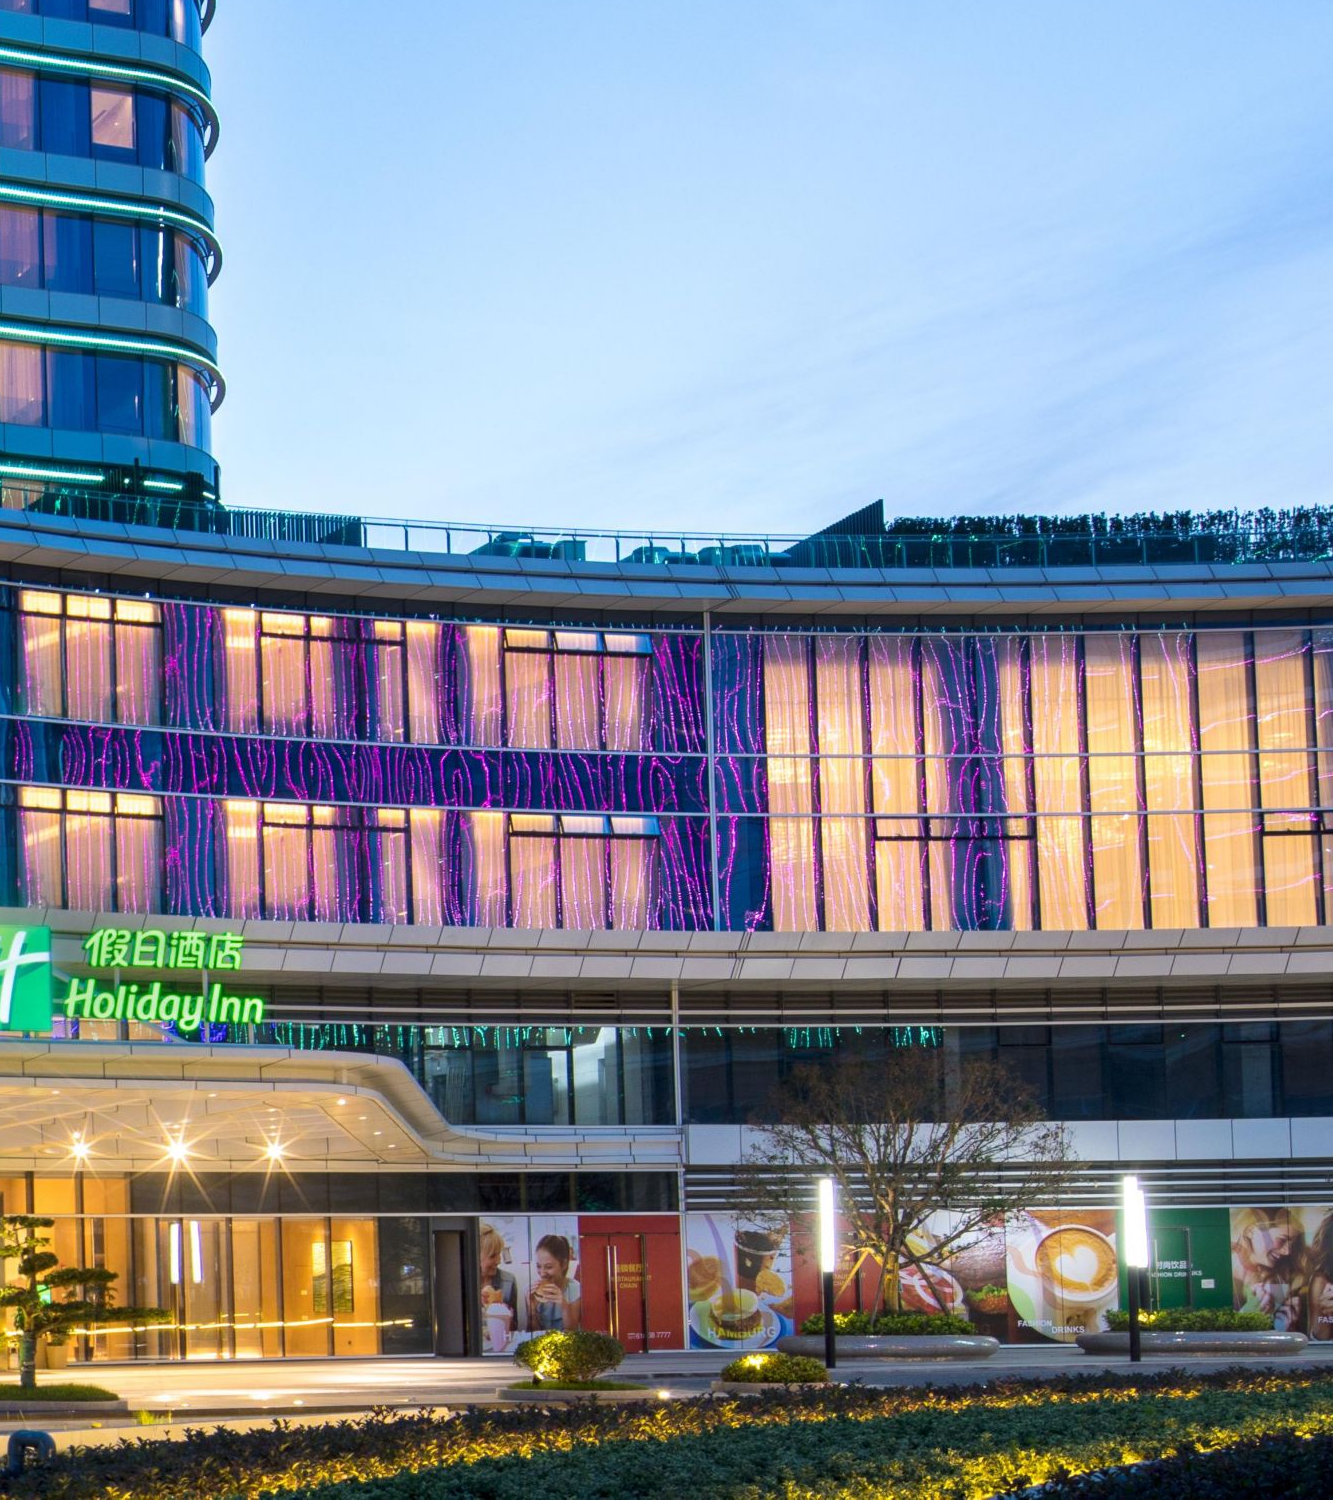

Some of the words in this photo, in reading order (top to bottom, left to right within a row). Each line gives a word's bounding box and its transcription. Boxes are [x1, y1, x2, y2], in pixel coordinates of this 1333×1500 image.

[84, 928, 245, 970] 假日酒店
[64, 978, 205, 1031] Holiday
[208, 983, 264, 1024] Inn
[1051, 1325, 1085, 1334] DRINKS
